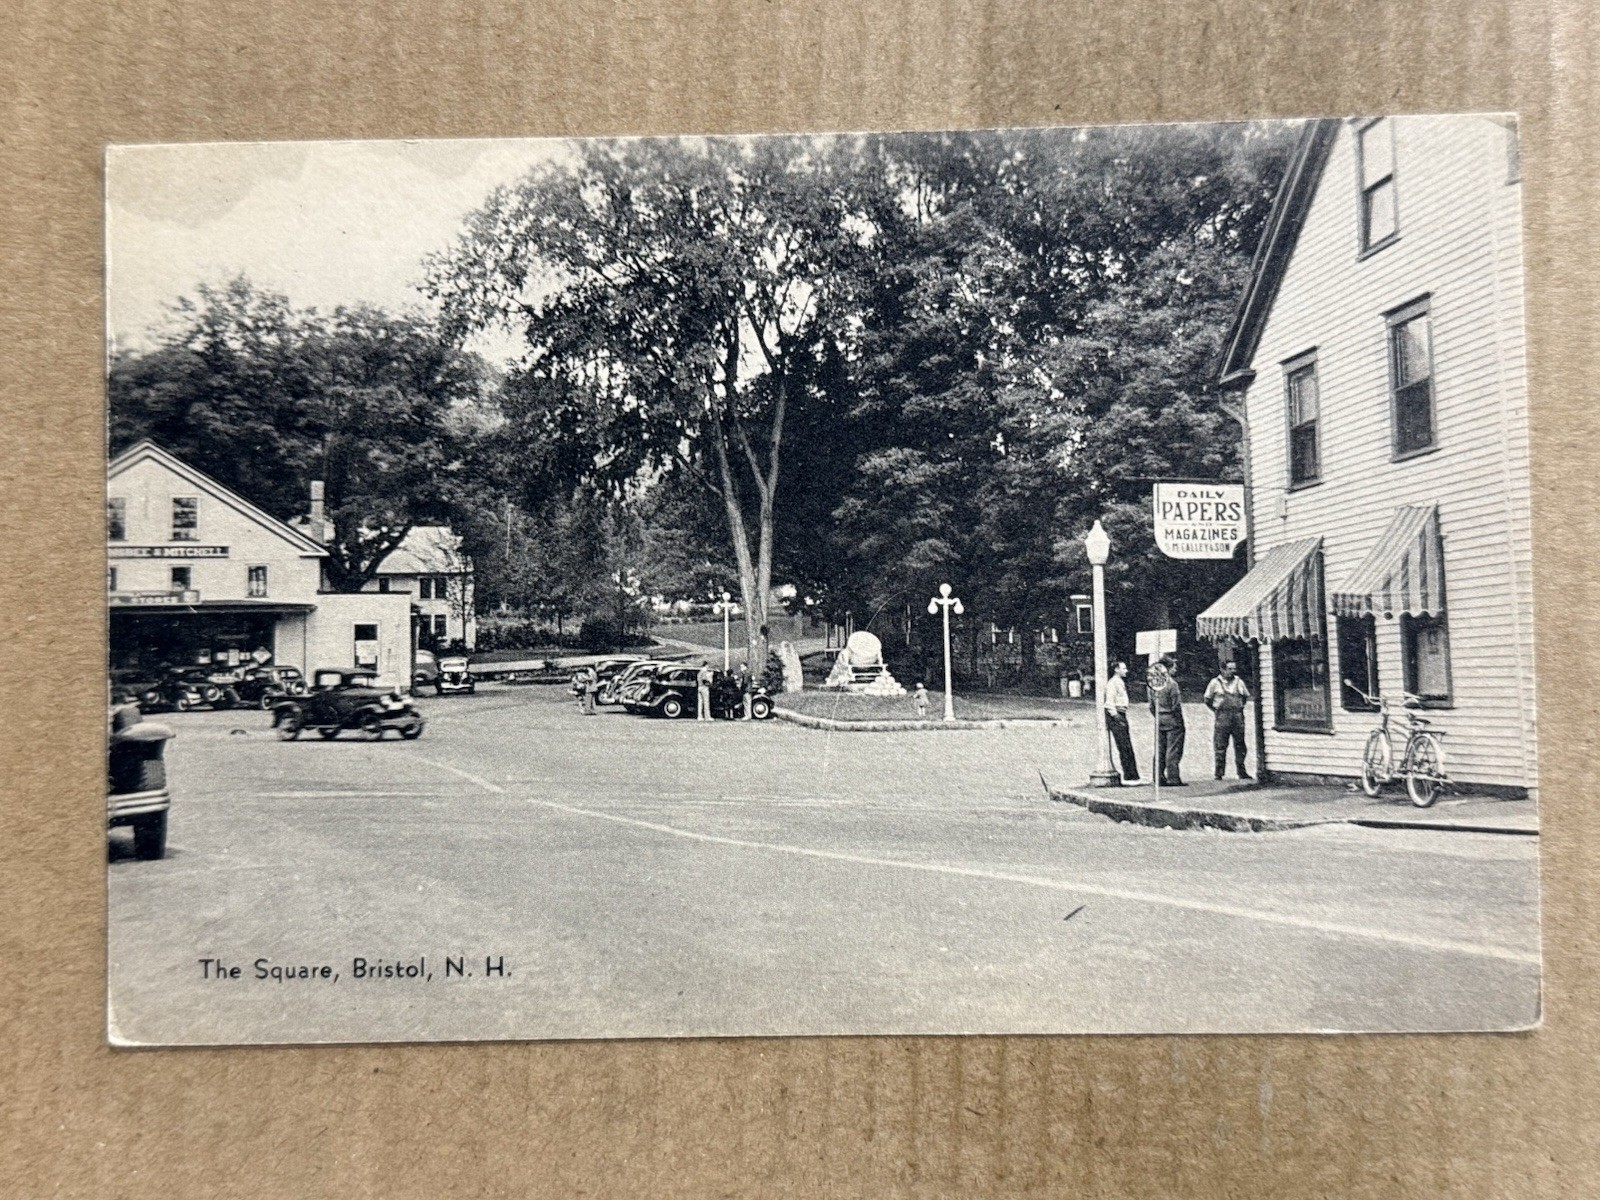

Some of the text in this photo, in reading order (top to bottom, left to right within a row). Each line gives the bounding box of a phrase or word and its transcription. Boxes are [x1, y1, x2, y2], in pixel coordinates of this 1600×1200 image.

[1177, 490, 1225, 499] DAILY
[1162, 501, 1241, 521] PAPERS
[1164, 528, 1238, 541] MAGAZINES
[163, 547, 222, 557] MITCHELL
[198, 956, 513, 983] The Square, Bristol, N. H.
